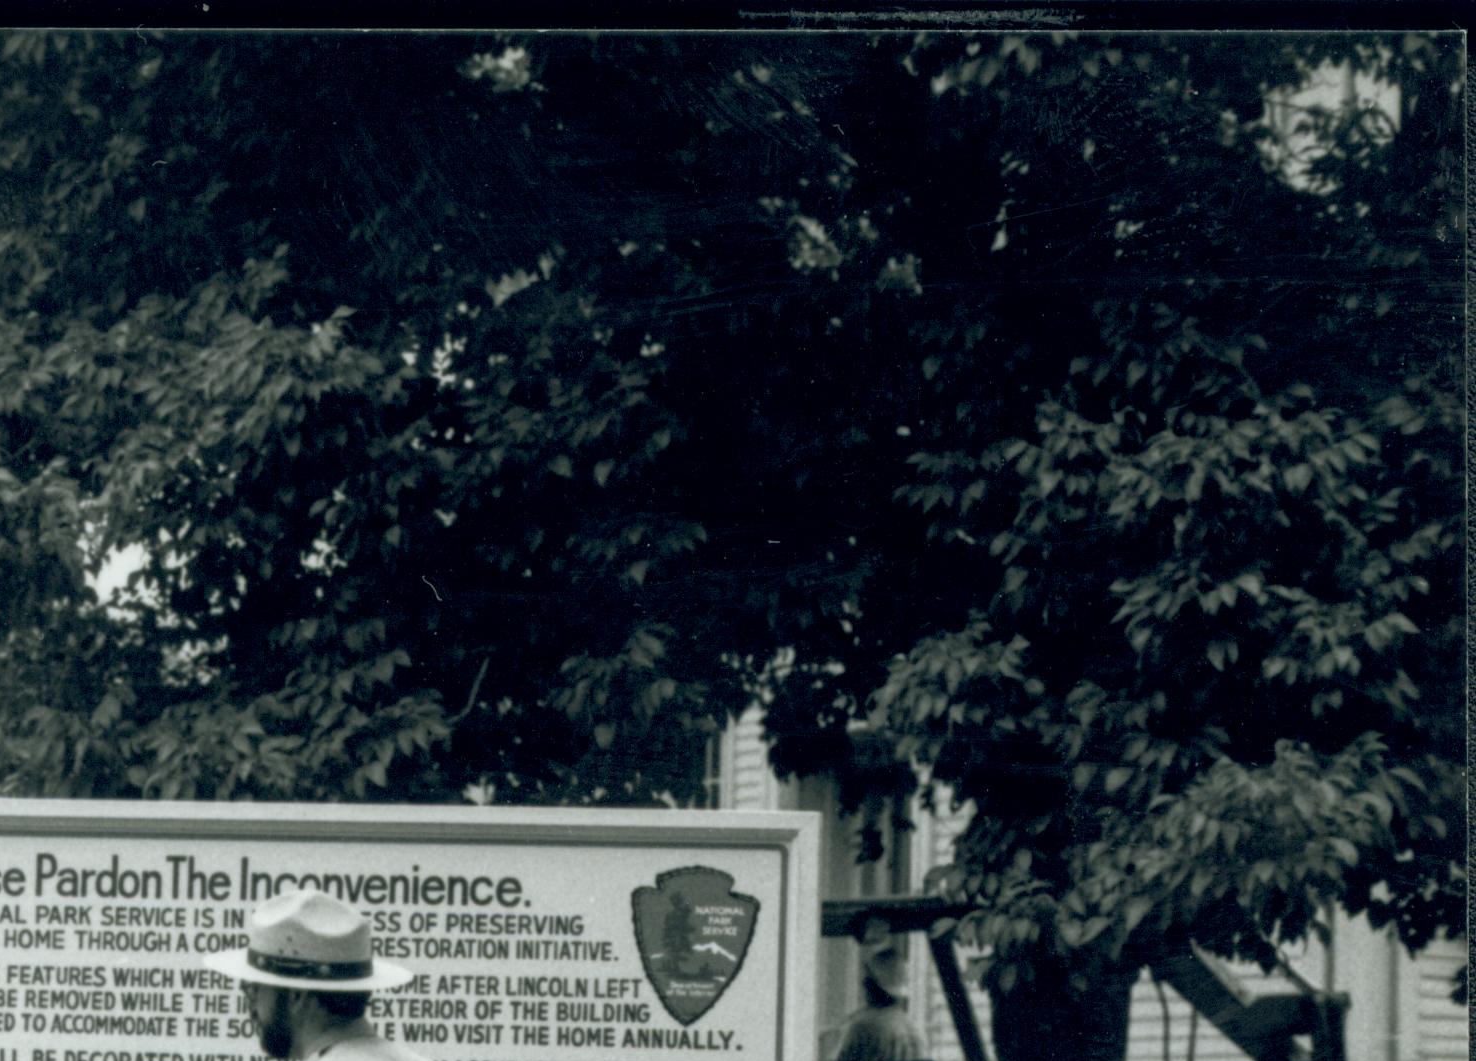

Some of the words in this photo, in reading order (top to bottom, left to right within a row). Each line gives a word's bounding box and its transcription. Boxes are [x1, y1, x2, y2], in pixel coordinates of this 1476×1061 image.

[35, 853, 161, 898] Pardon
[166, 855, 230, 900] The
[35, 905, 91, 923] PARK
[101, 906, 185, 926] SERVICE
[193, 907, 214, 927] IS
[223, 909, 244, 927] IN
[409, 912, 437, 932] OF
[445, 914, 583, 934] PRESERVING
[694, 905, 745, 916] NATIONAL
[708, 916, 732, 925] PARK
[4, 929, 64, 948] HOME
[74, 930, 170, 951] THROUGH
[176, 932, 188, 951] A
[371, 937, 508, 958] RESTORATION
[516, 940, 618, 960] INITIATIVE.
[702, 926, 737, 936] SERVICE
[6, 965, 105, 986] FEATURES
[112, 968, 173, 987] WHICH
[436, 975, 498, 994] AFTER
[505, 977, 587, 996] LINCOLN
[594, 978, 641, 998] LEFT
[25, 990, 115, 1009] REMOVED
[121, 993, 182, 1012] WHILE
[192, 993, 228, 1013] THE
[370, 998, 466, 1018] EXTERIOR
[474, 1000, 501, 1019] OF
[510, 1001, 548, 1020] THE
[556, 1003, 649, 1021] BUILDING
[21, 1013, 45, 1031] TO
[51, 1014, 176, 1035] ACCOMMODATE
[184, 1017, 218, 1036] THE
[402, 1023, 447, 1042] WHO
[453, 1024, 503, 1043] VISIT
[510, 1025, 548, 1045] THE
[557, 1027, 614, 1046] HOME
[622, 1029, 742, 1049] ANNUALLY.
